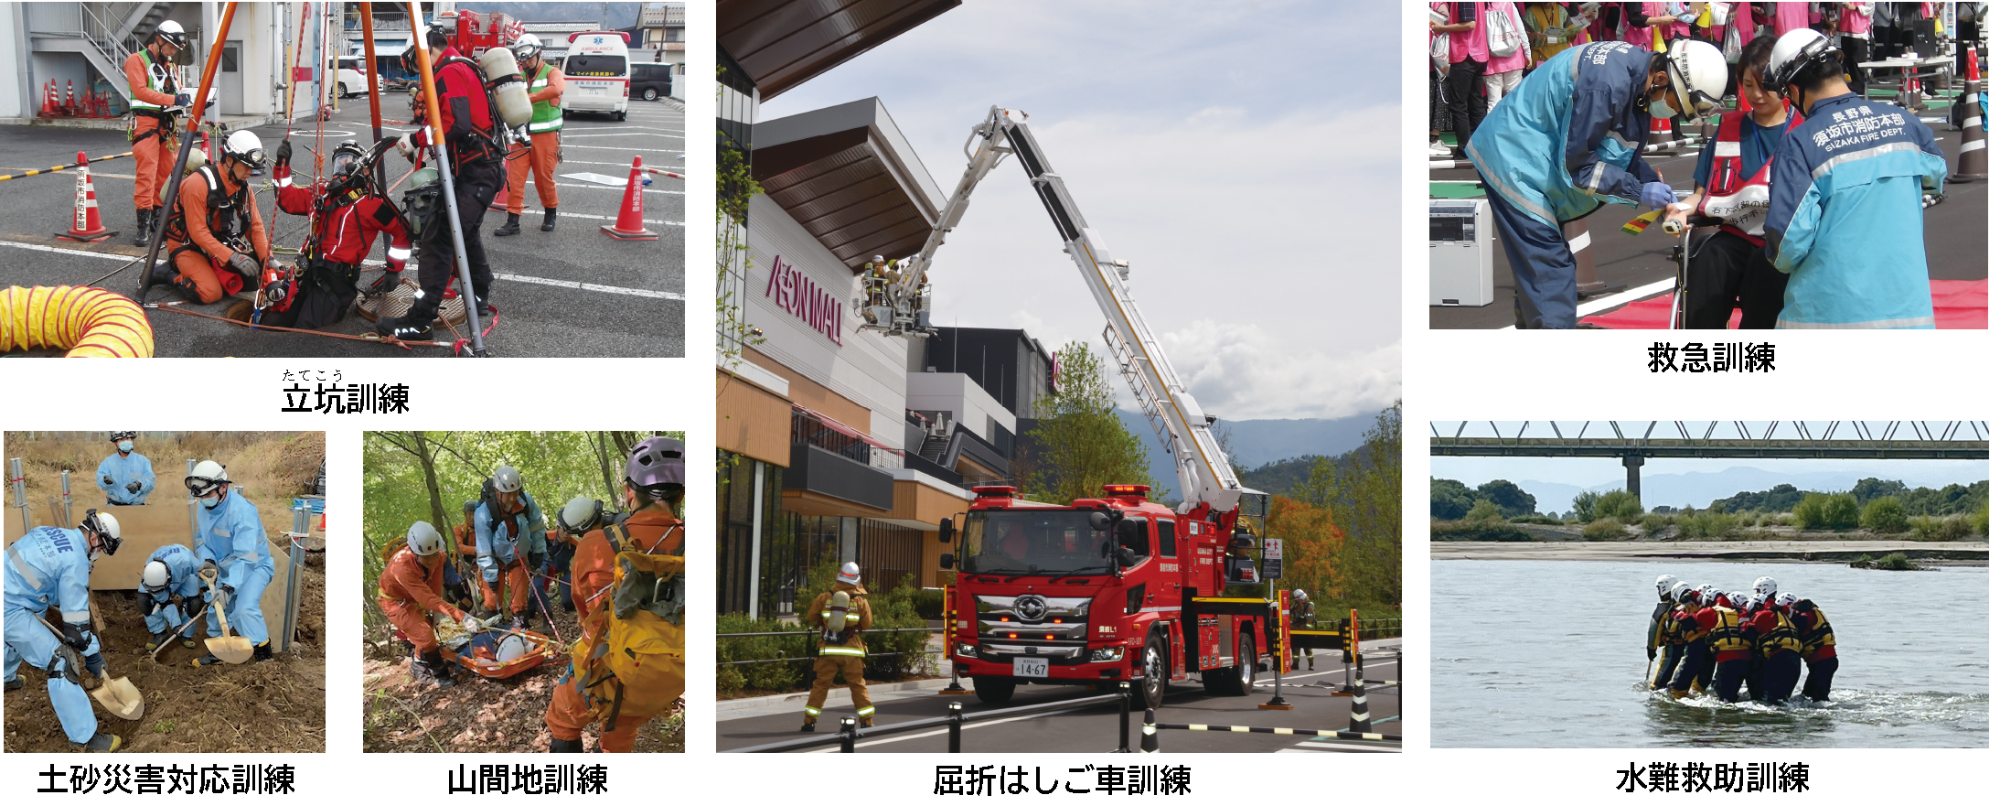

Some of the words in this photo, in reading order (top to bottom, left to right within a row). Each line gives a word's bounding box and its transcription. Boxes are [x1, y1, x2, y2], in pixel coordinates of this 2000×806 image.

[1832, 105, 1873, 123] 長野県
[1812, 112, 1906, 147] 須坂市消防本部
[1861, 130, 1880, 143] FIRE
[1880, 126, 1907, 138] DEPT.
[809, 281, 845, 347] MALL
[1021, 663, 1046, 675] 14-67
